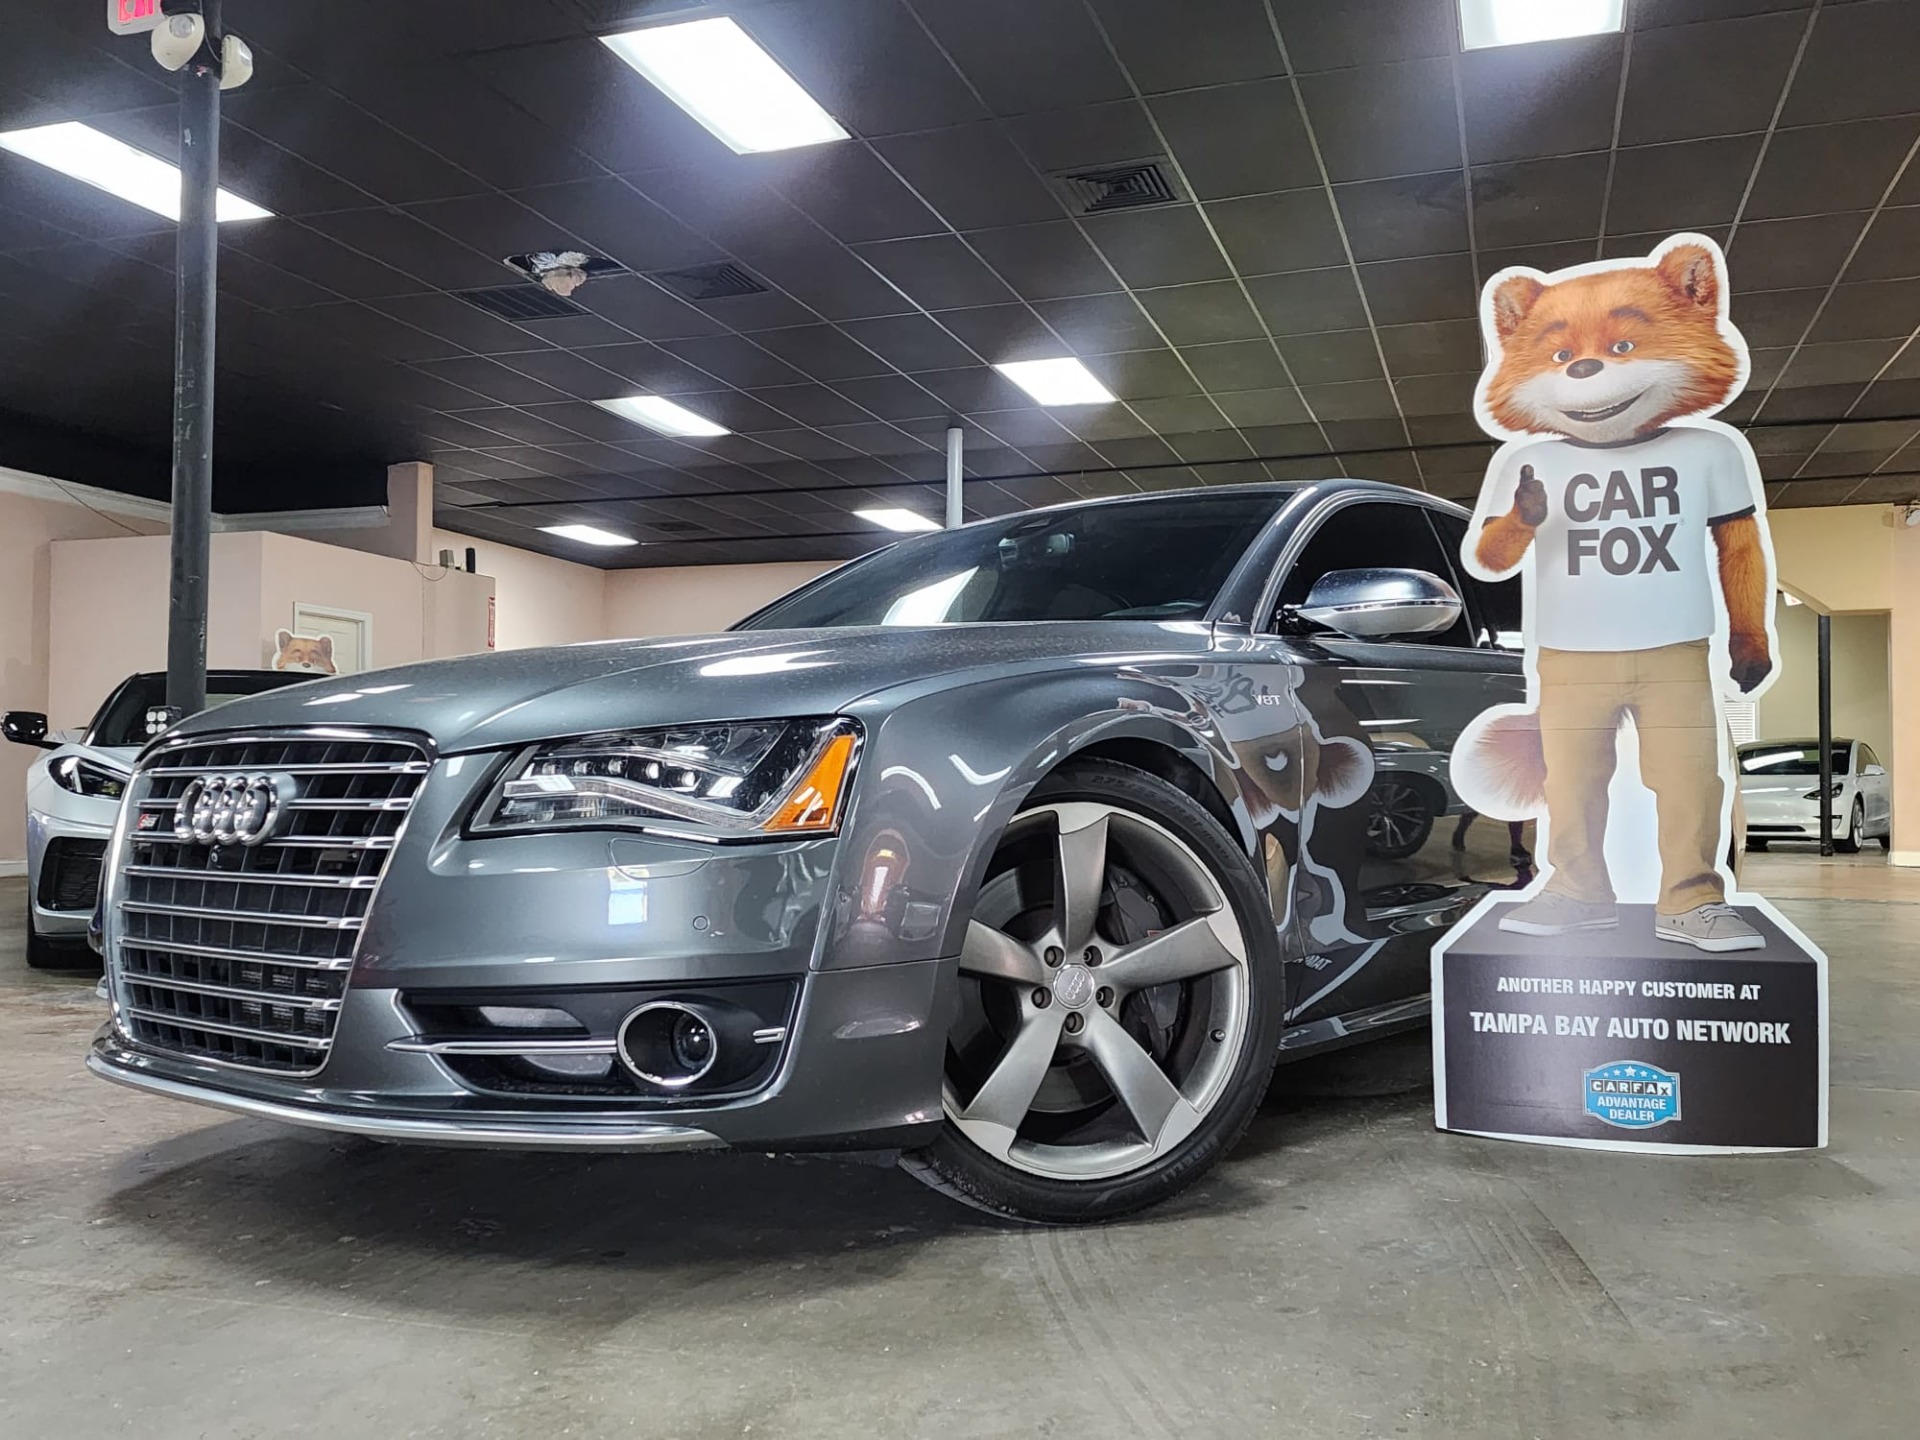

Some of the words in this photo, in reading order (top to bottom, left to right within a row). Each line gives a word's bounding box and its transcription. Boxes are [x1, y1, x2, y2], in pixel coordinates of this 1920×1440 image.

[1563, 466, 1681, 523] CAR
[1567, 523, 1681, 576] FOX
[1251, 694, 1281, 706] V8T
[1496, 976, 1574, 995] ANOTHER
[1579, 979, 1637, 997] HAPPY
[1641, 981, 1736, 1000] CUSTOMER
[1739, 984, 1762, 1001] AT
[1469, 1011, 1549, 1036] TAMPA
[1554, 1015, 1600, 1037] BAY
[1606, 1017, 1670, 1040] AUTO
[1676, 1019, 1792, 1045] NETWORK
[1591, 1079, 1672, 1096] CARFAX
[1597, 1095, 1667, 1110] ADVANTAGE
[1609, 1108, 1655, 1122] DEALER
